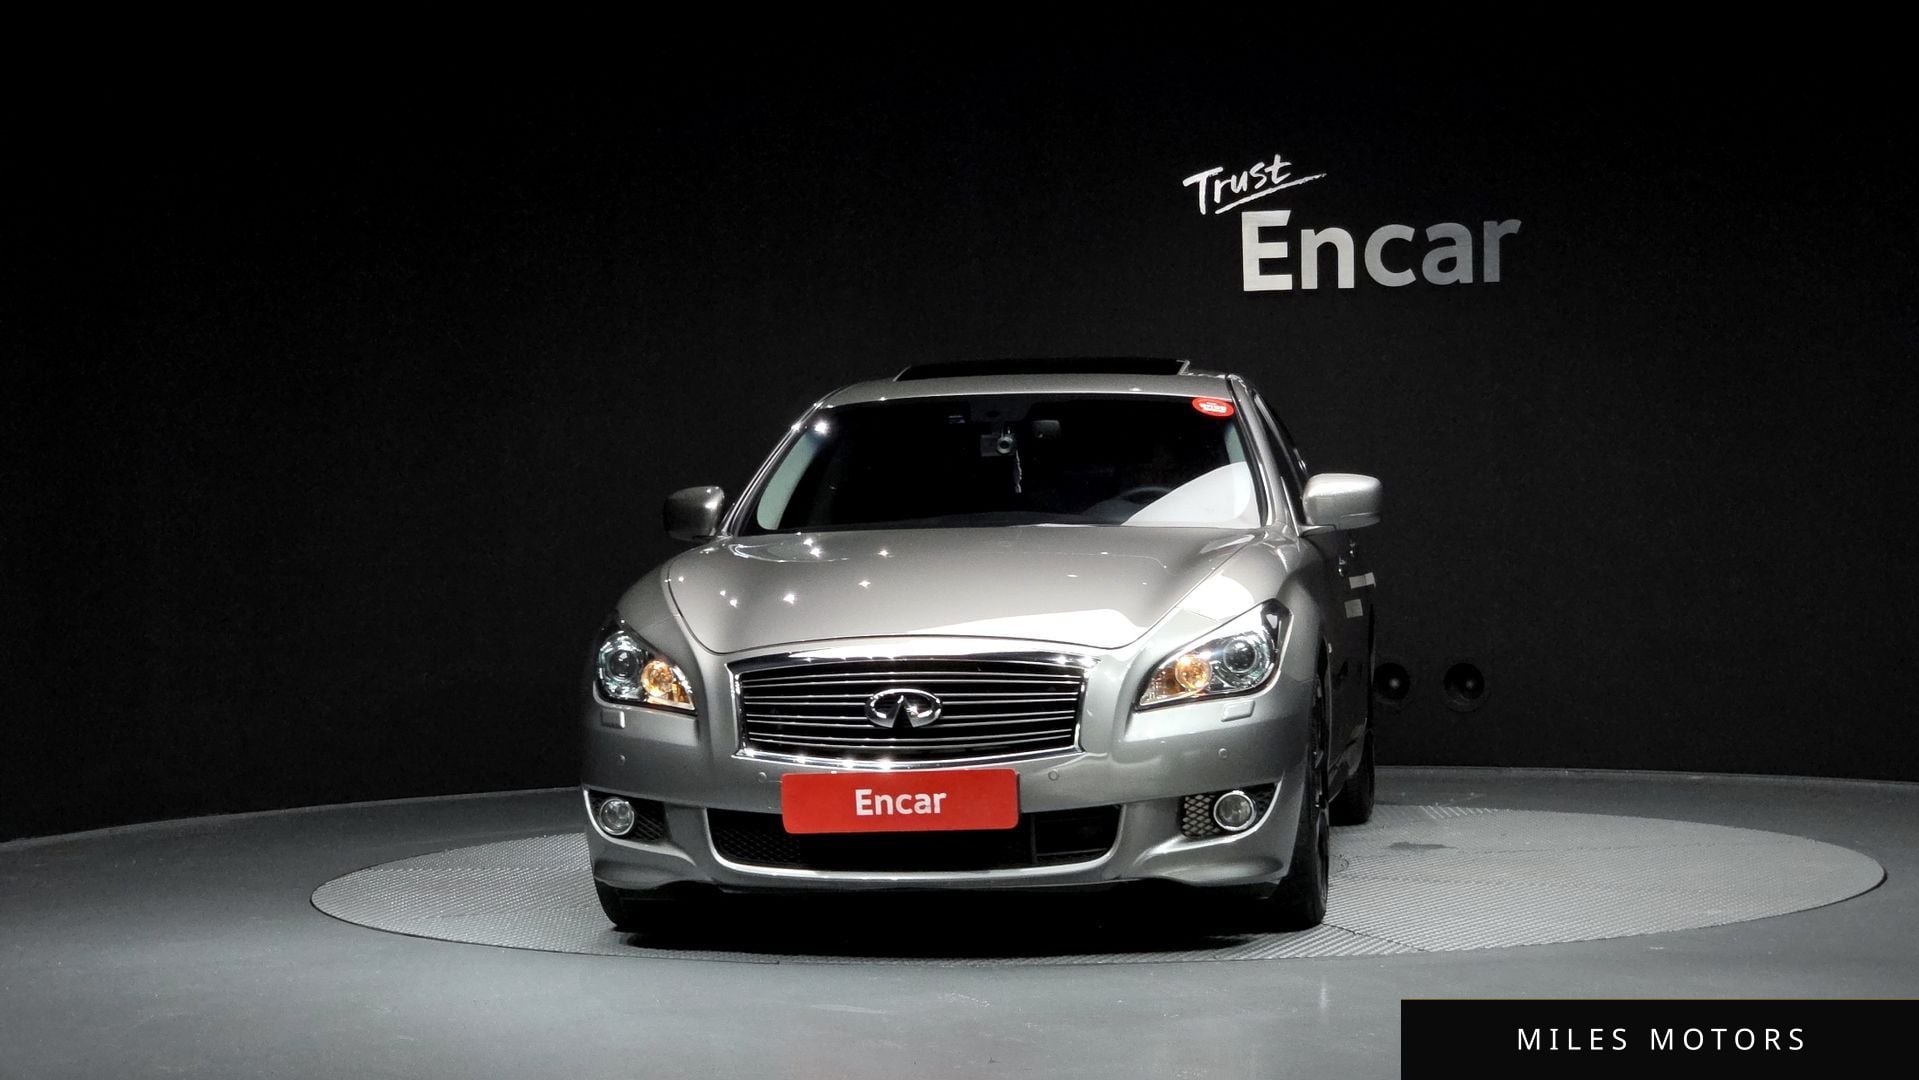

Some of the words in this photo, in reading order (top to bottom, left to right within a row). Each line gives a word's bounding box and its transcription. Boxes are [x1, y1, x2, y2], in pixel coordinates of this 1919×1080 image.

[1183, 154, 1292, 215] Trust
[1241, 209, 1522, 292] Encar
[854, 788, 947, 816] Encar
